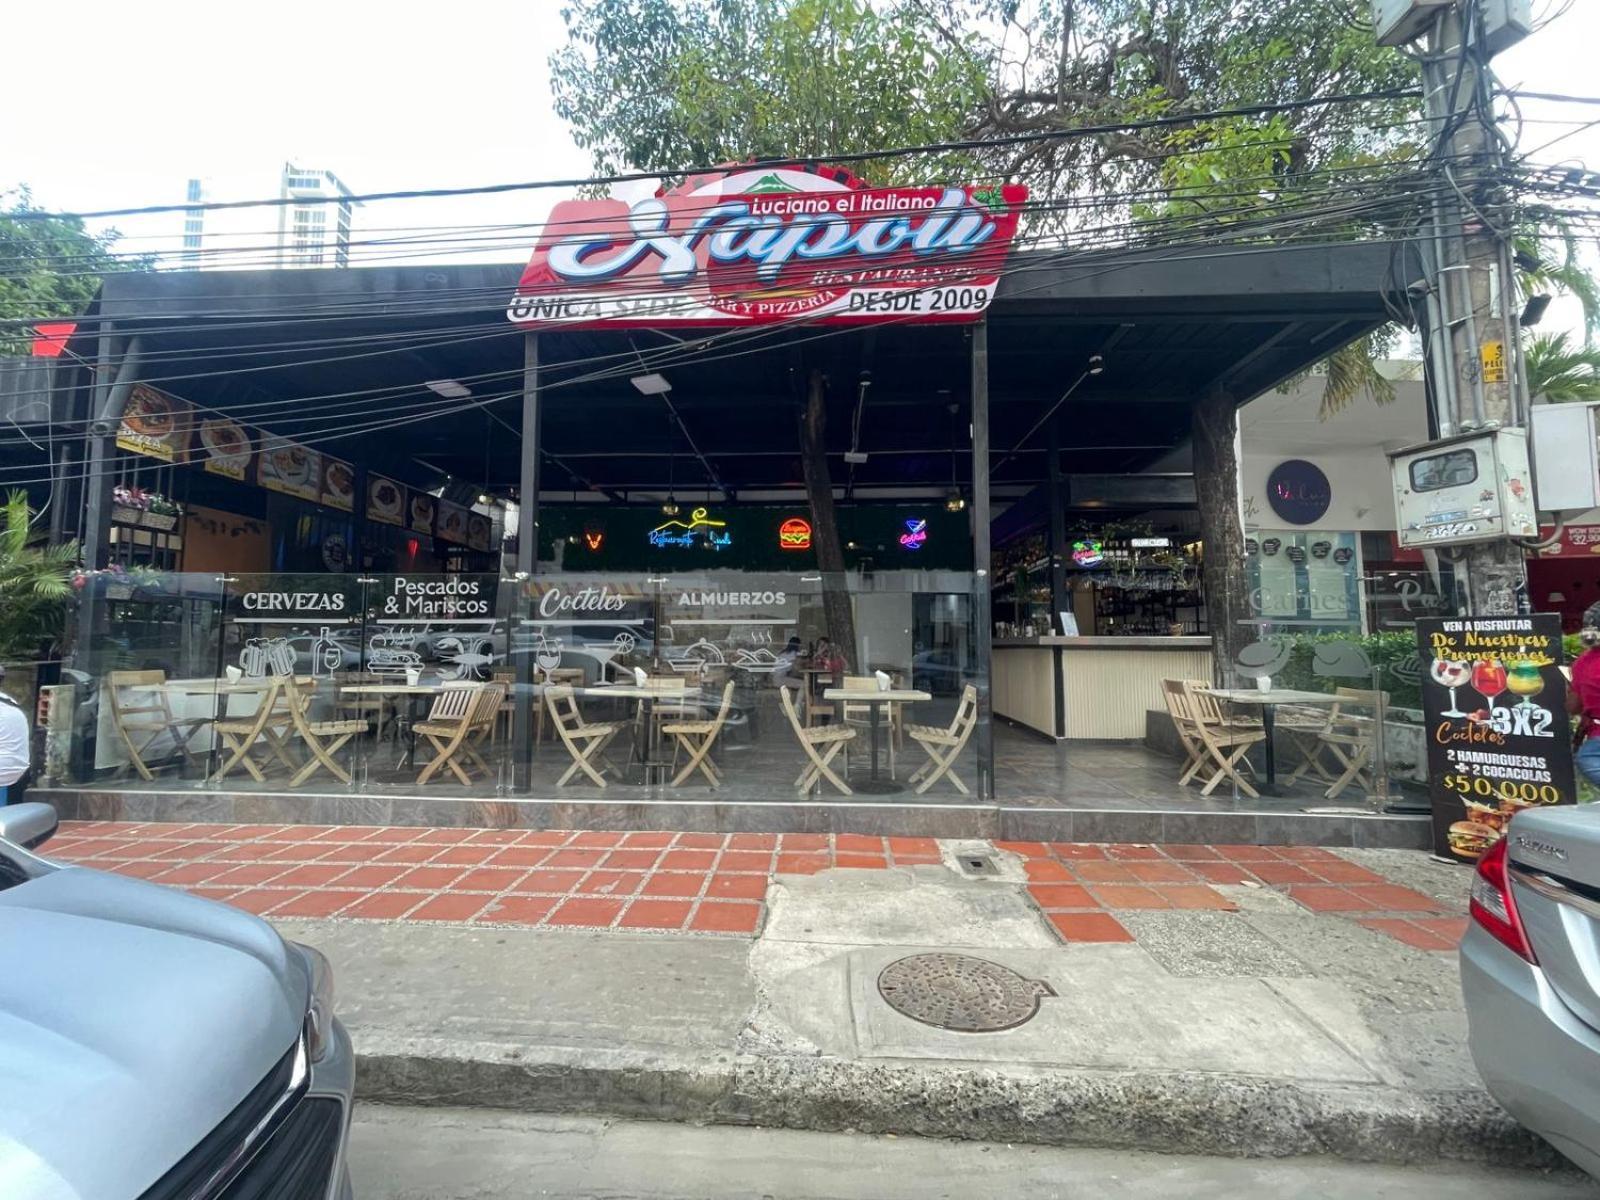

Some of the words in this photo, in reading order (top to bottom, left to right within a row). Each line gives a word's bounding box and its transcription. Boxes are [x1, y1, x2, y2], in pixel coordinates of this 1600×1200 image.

[752, 196, 830, 215] Luciano
[837, 197, 856, 212] el
[861, 193, 936, 211] Italiano
[743, 302, 754, 314] Y
[758, 290, 836, 314] PIZZERIA
[850, 291, 922, 312] DESDE
[930, 288, 988, 311] 2009
[394, 577, 480, 595] Pescados
[242, 592, 345, 610] CERVEZAS
[384, 596, 399, 614] &
[405, 596, 488, 614] Mariscos
[539, 586, 627, 618] Cocteles
[678, 591, 787, 606] ALMUERZOS
[1250, 587, 1349, 612] Carnes
[1442, 621, 1463, 632] VEN
[1464, 621, 1473, 631] A
[1474, 619, 1532, 631] DISFRUTAR
[1430, 632, 1457, 648] De
[1464, 631, 1550, 648] Nuestras
[1436, 721, 1505, 746] Cocteles
[1447, 749, 1455, 761] 2
[1457, 750, 1547, 769] HAMURGUESAS
[1472, 764, 1481, 776] 2
[1482, 766, 1552, 783] COCACOLAS
